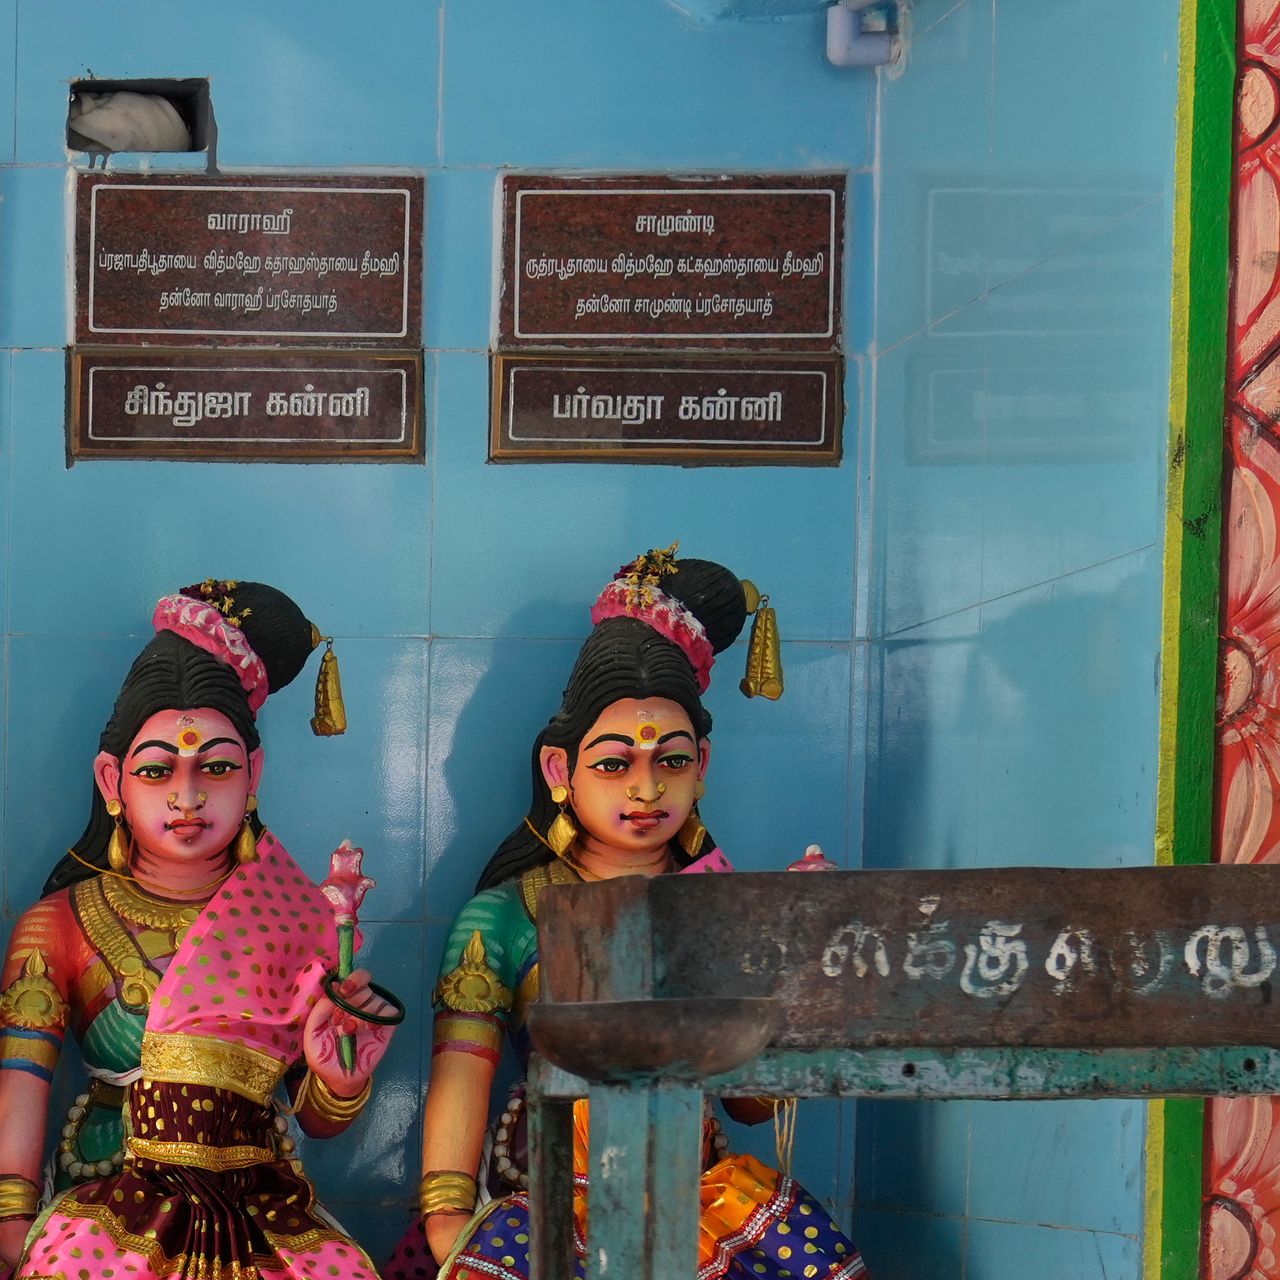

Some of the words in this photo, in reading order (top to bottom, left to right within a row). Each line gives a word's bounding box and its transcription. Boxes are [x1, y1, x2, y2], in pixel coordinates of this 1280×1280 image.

[207, 207, 294, 235] வாராஹீ
[635, 208, 715, 237] சாமுண்டி
[98, 246, 197, 276] ப்ரஜாபதிபூதாயை
[203, 248, 262, 277] வித்மஹே
[264, 251, 358, 279] கதாஹஸ்தாயை
[359, 249, 400, 280] தீமஹி
[525, 252, 608, 281] ருத்ரபூதாயை
[611, 251, 674, 280] வித்மஹே
[676, 252, 779, 280] கட்கஹஸ்தாயை
[780, 250, 824, 280] தீமஹி
[158, 286, 212, 313] தன்னோ
[213, 286, 264, 314] வாராஹீ
[265, 287, 338, 316] ப்ரசோதயாத்
[574, 293, 631, 321] தன்னோ
[633, 291, 693, 320] சாமுண்டி
[695, 291, 773, 320] ப்ரசோதயாத்
[124, 381, 253, 427] சிந்துஜா
[265, 383, 370, 417] கன்னி
[552, 385, 665, 425] பர்வதா
[678, 387, 783, 422] கன்னி
